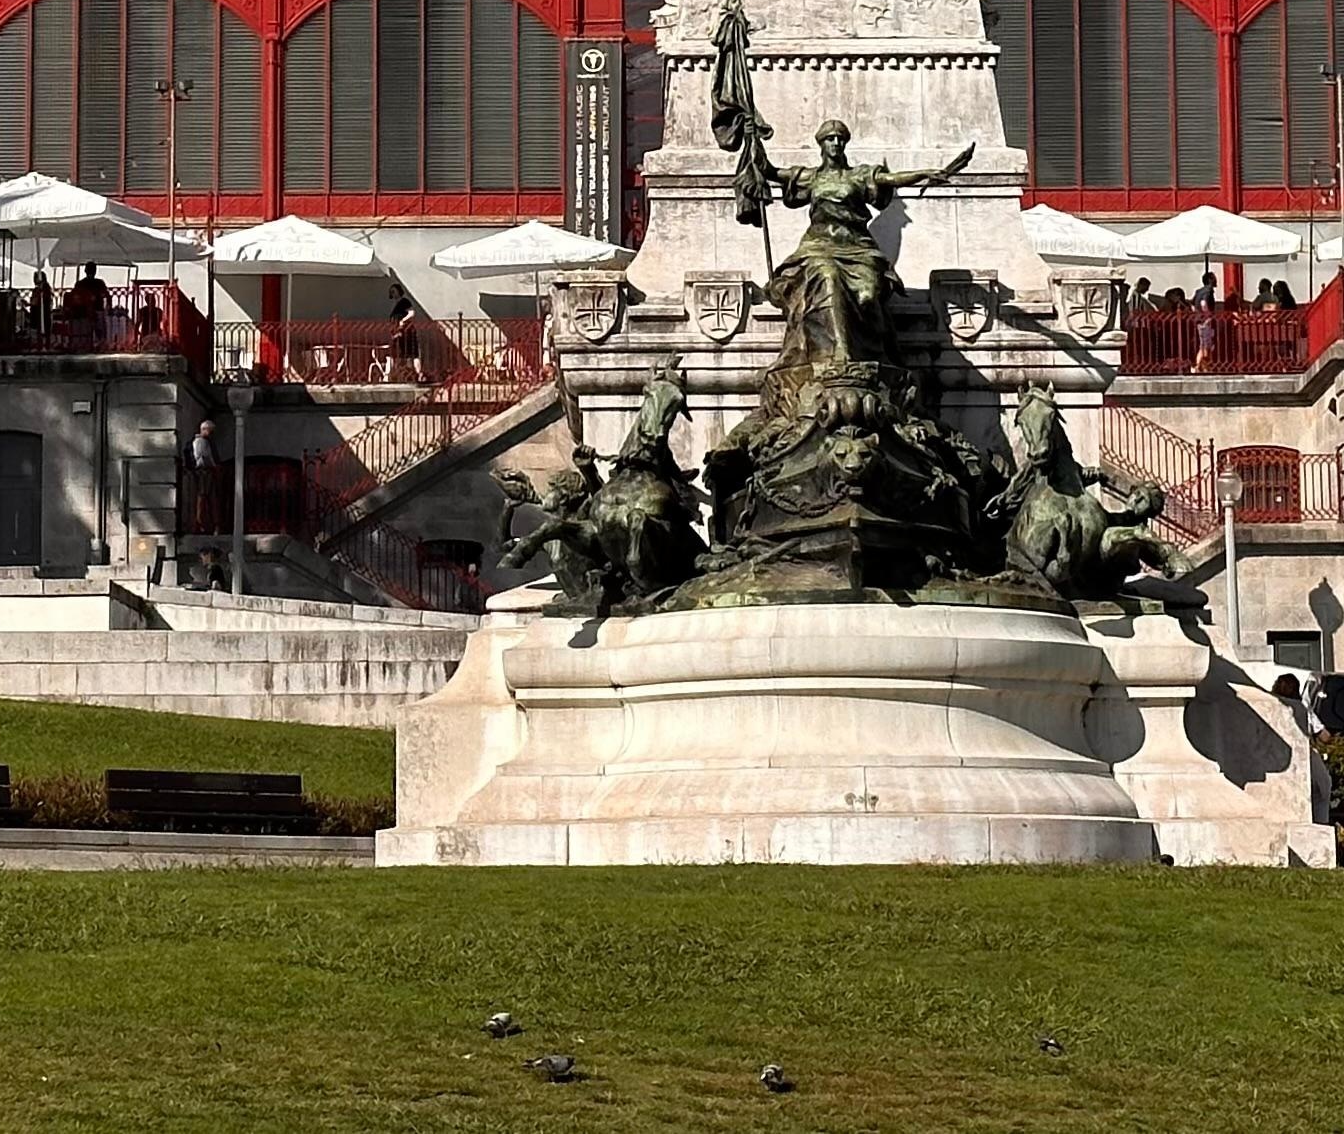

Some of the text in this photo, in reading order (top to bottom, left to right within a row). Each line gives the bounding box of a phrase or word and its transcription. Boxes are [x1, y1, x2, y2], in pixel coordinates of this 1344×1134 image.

[575, 84, 583, 117] MUSIC
[589, 85, 597, 140] ACTIVITIES
[602, 84, 610, 150] RESTAURANT
[575, 119, 583, 140] LIVE
[589, 142, 597, 195] TOURISTIC
[602, 154, 610, 221] WORKSHOPS
